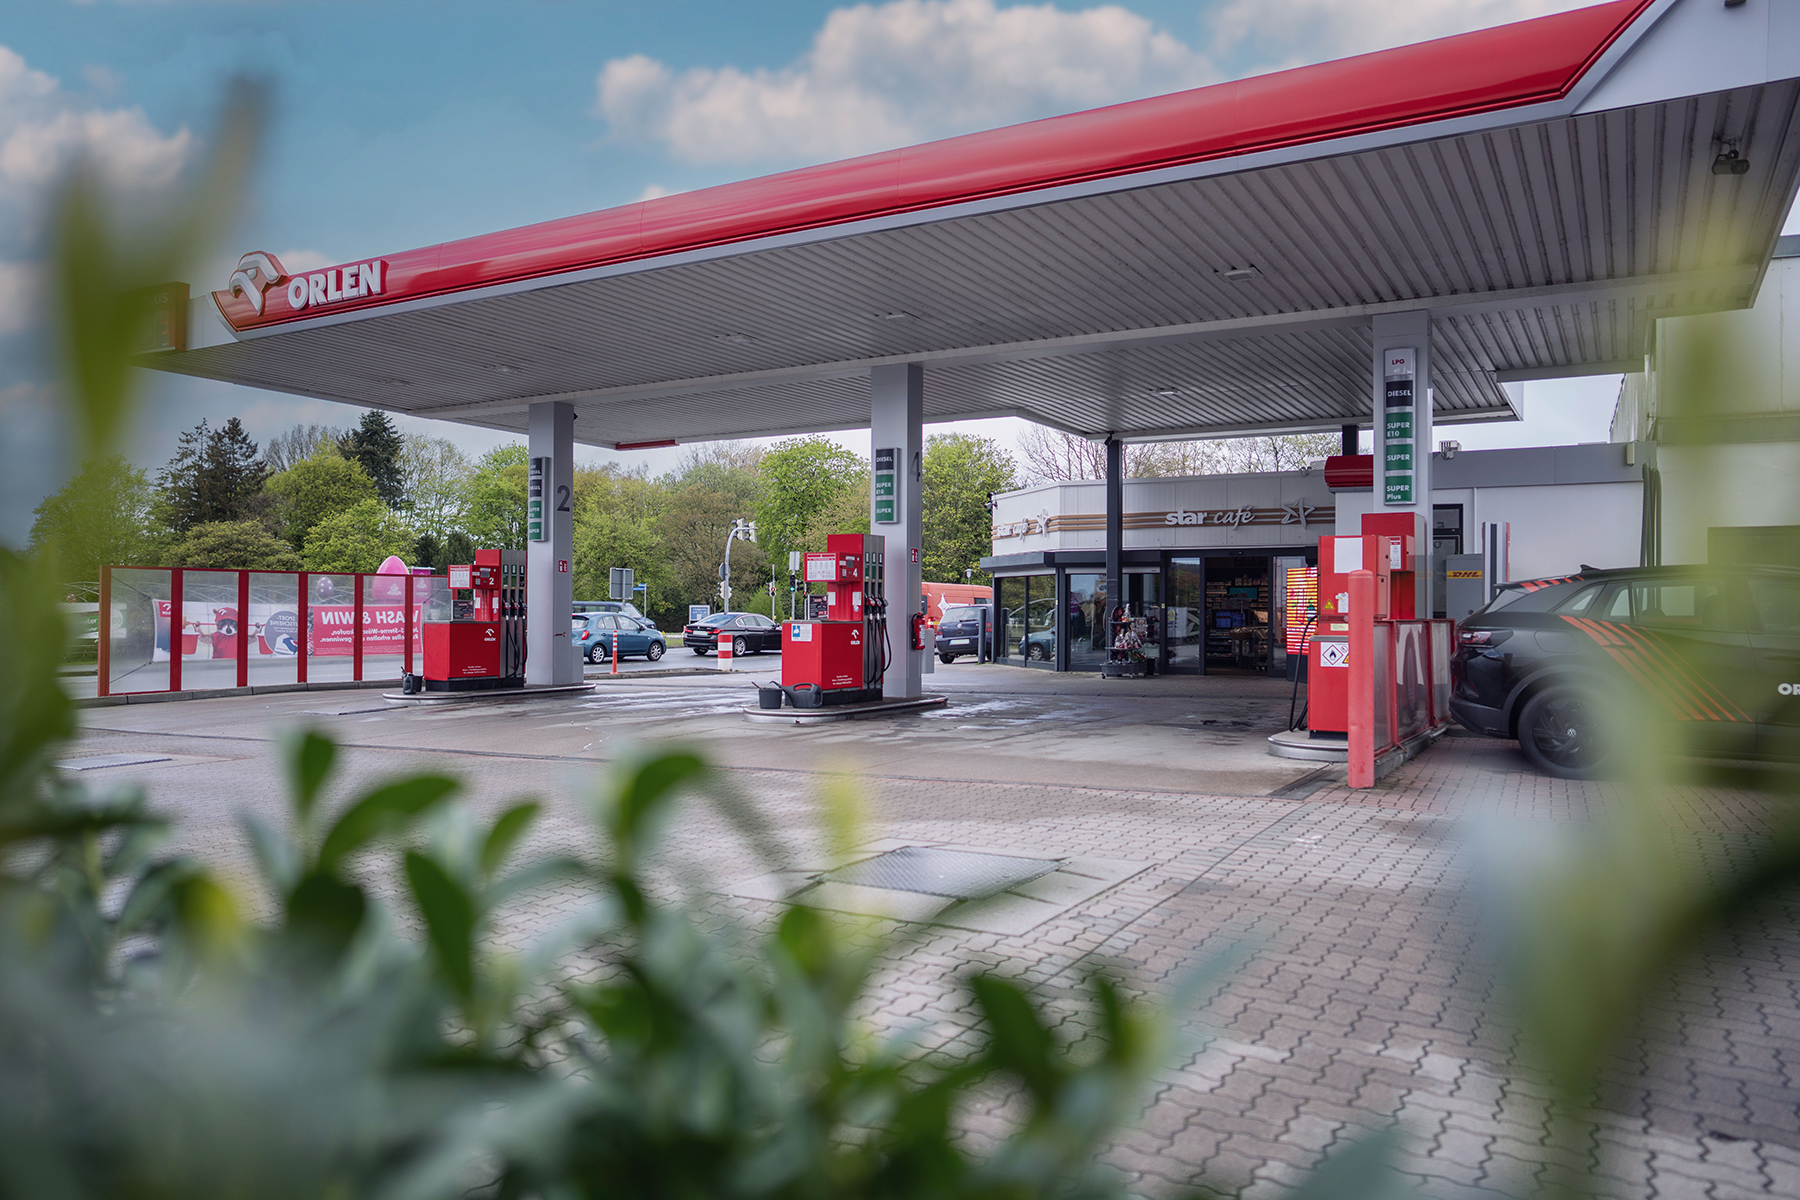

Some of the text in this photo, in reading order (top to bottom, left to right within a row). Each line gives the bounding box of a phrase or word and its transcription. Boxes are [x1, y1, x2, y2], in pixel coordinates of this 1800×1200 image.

[287, 260, 382, 310] ORLEN
[1387, 389, 1412, 398] DIESEL
[1386, 421, 1411, 430] SUPER
[1387, 430, 1401, 438] E10
[1386, 453, 1411, 462] SUPER
[910, 451, 921, 482] 4
[1386, 484, 1411, 493] SUPER
[556, 485, 571, 512] 2
[1386, 491, 1402, 500] Plus
[1164, 503, 1256, 531] star café
[996, 522, 1013, 537] star
[852, 568, 859, 577] 4
[488, 577, 495, 585] 2
